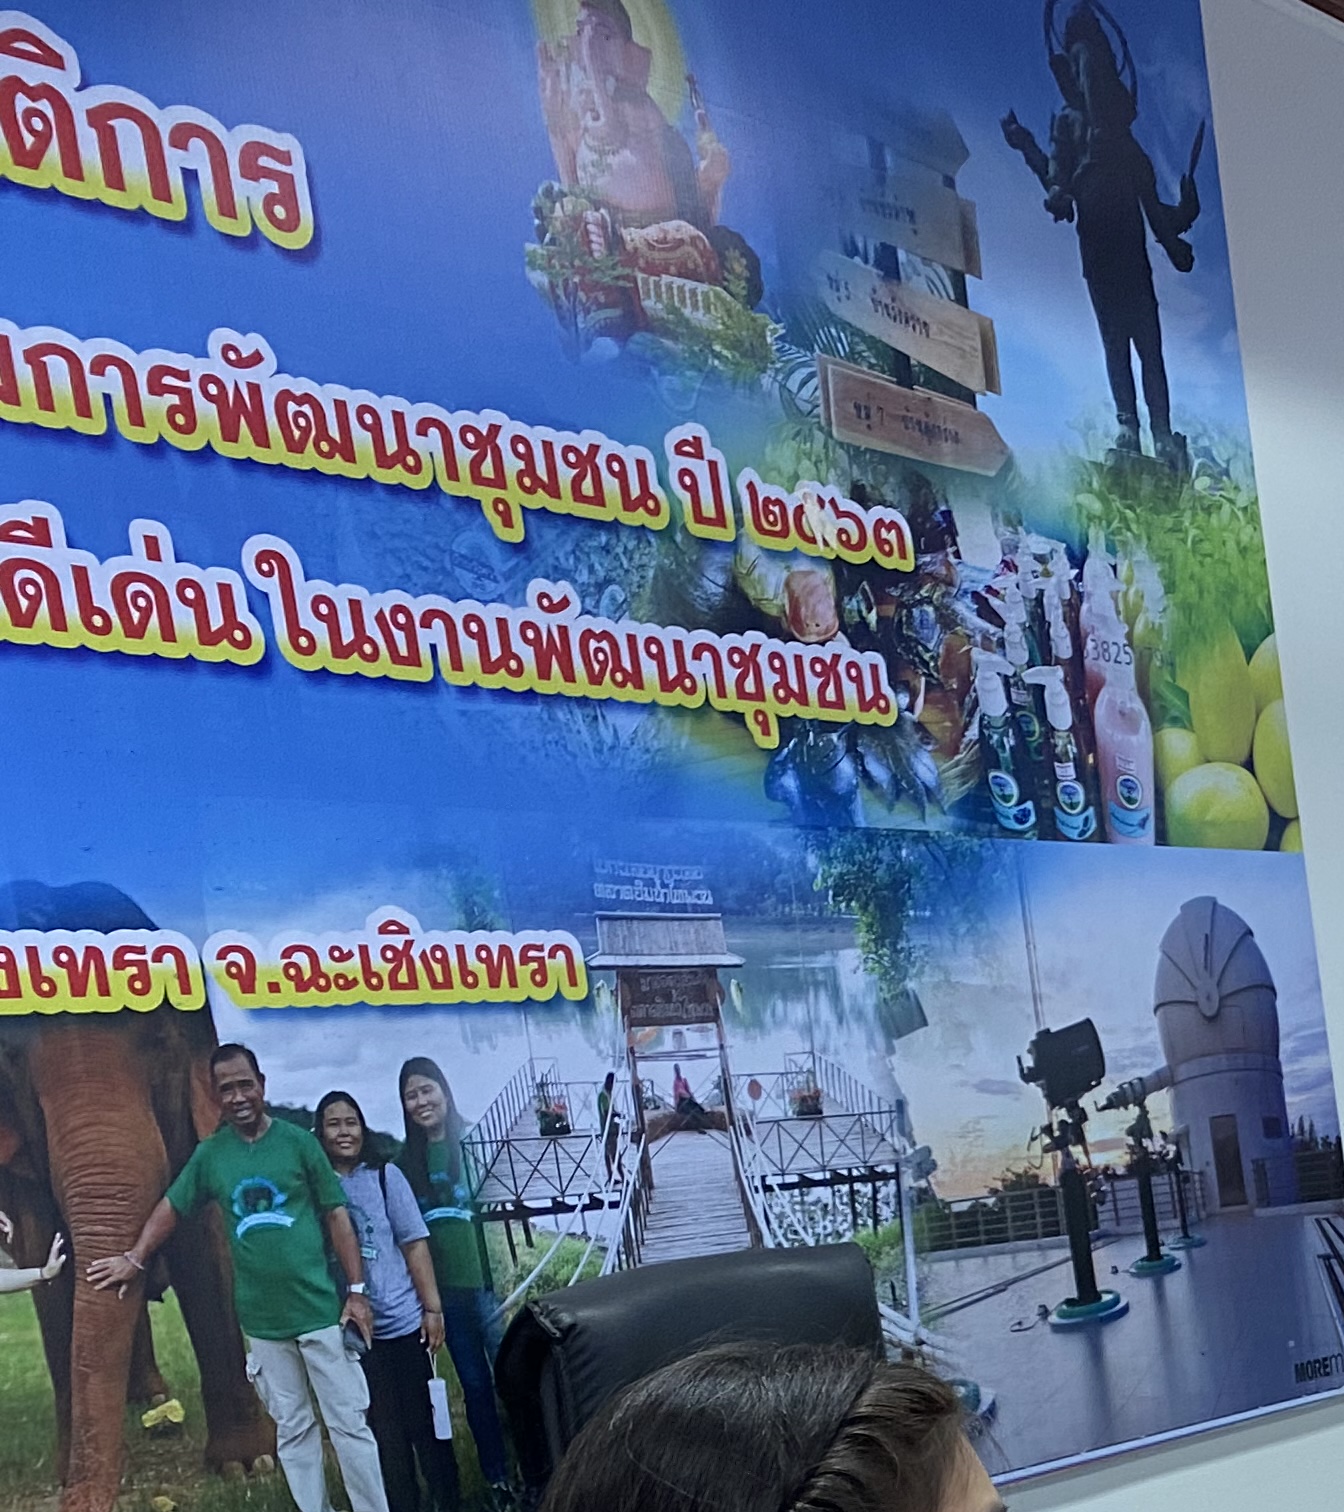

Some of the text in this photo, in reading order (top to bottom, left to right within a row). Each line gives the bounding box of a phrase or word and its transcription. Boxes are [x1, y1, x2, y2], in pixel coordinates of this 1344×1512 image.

[674, 437, 728, 529] ปี
[255, 549, 891, 738] ในงานพัฒนาชุมชน
[216, 919, 578, 993] จ.ฉะเชิงเทรา
